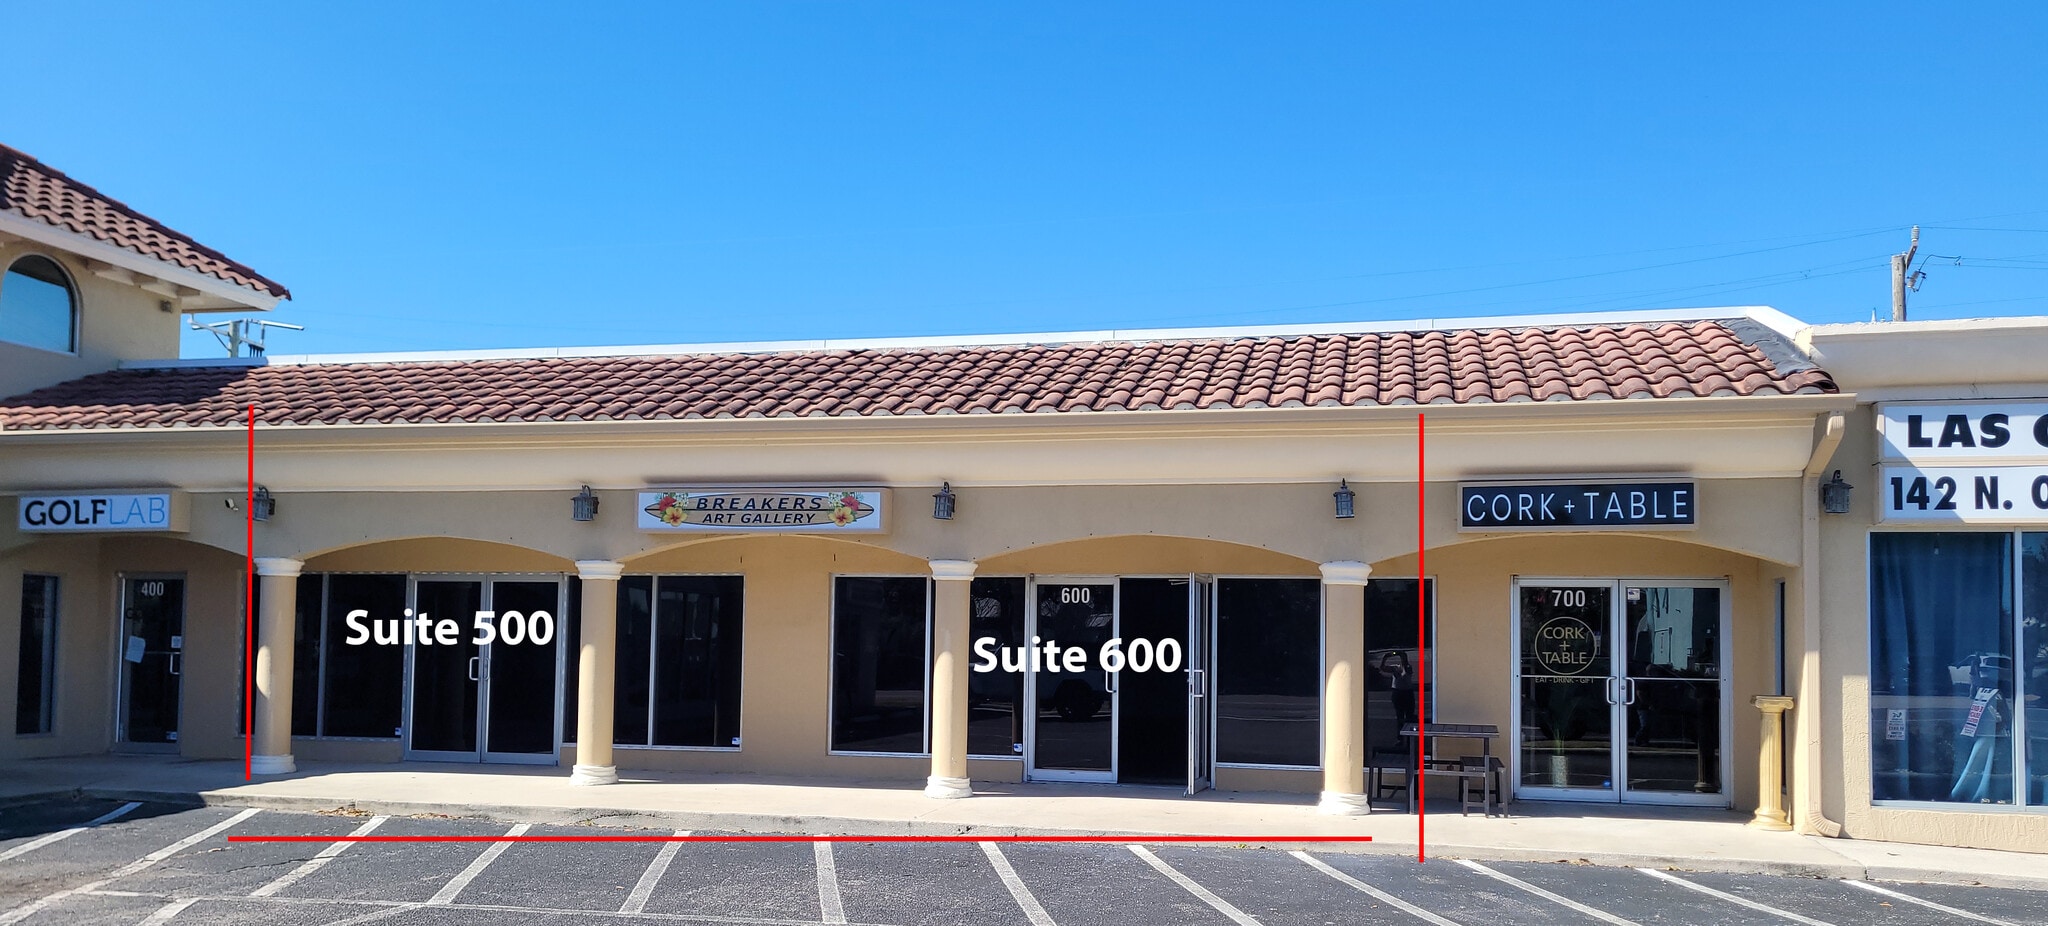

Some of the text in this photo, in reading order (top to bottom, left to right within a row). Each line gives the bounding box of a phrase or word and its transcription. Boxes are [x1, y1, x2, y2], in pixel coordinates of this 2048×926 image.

[1908, 413, 2011, 449] LAS
[1891, 476, 1957, 511] 142
[1974, 475, 2013, 511] N.
[25, 497, 166, 526] GOLFLAB
[696, 497, 823, 511] BREAKERS
[1467, 490, 1688, 521] CORK + TABLE
[702, 513, 816, 524] ART GALLERY
[140, 582, 164, 597] 400
[1060, 587, 1091, 605] 600
[1551, 589, 1586, 607] 700
[1543, 626, 1585, 640] CORK
[1542, 651, 1588, 665] TABLE
[1553, 676, 1575, 684] DRINK
